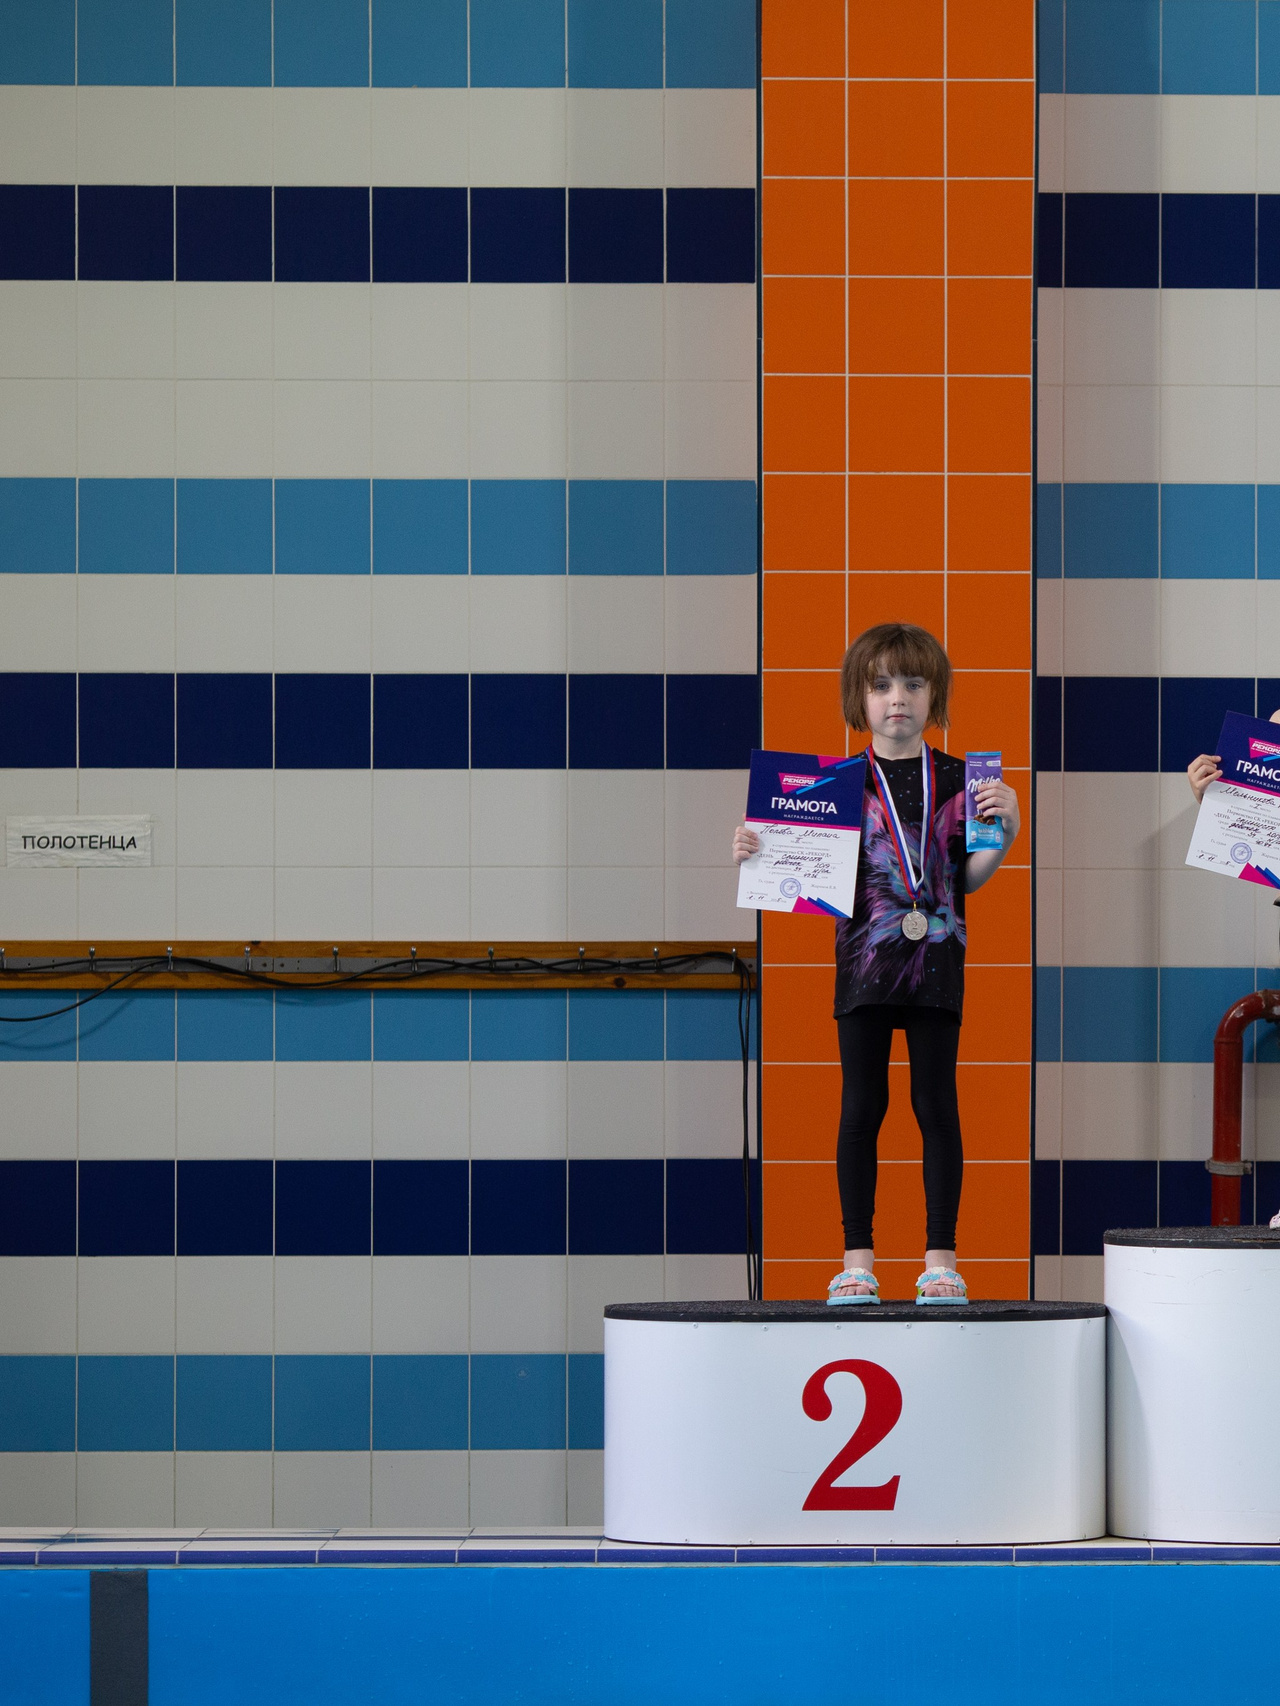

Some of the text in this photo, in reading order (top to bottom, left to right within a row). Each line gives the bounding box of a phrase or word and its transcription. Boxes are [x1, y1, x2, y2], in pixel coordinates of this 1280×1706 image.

[771, 796, 838, 814] ГРАМОТА
[22, 835, 137, 851] ПОЛОТЕНЦА
[802, 1359, 903, 1511] 2
